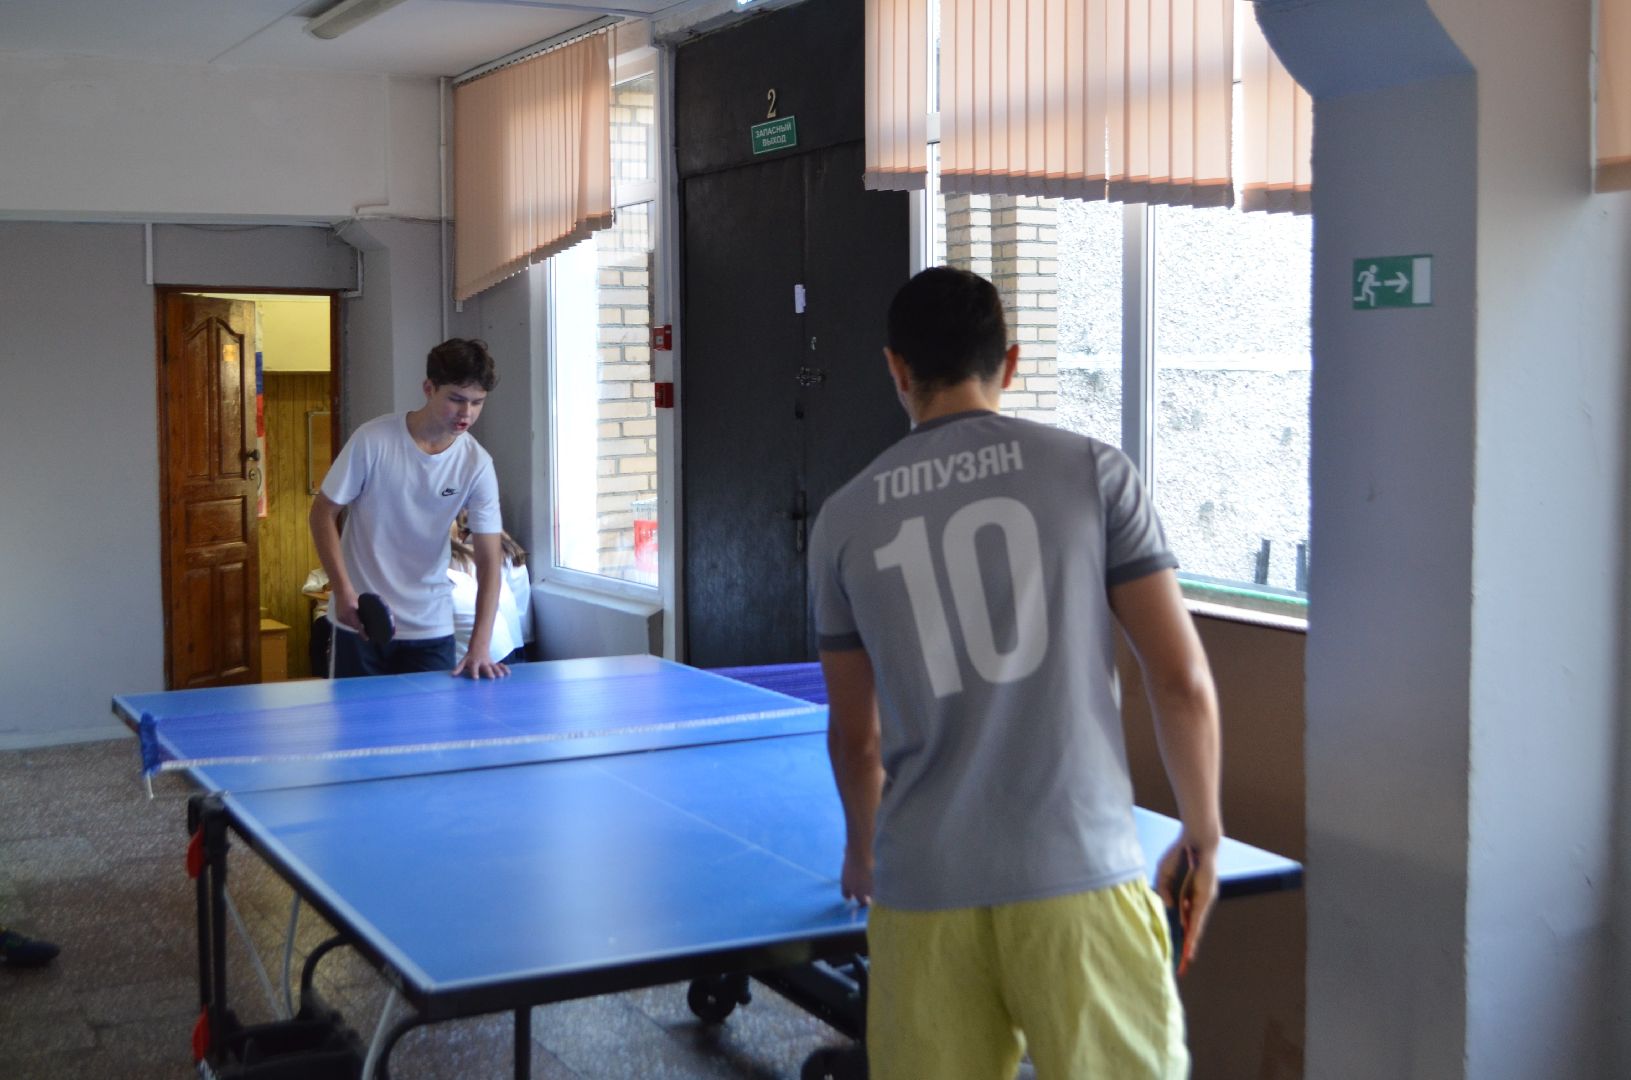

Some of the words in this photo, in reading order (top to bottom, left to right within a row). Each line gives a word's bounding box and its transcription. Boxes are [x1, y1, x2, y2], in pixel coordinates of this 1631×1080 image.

[768, 89, 776, 118] 2
[756, 122, 791, 138] ЗАПАСНЫЙ
[763, 135, 786, 147] ВЫХОД
[873, 440, 1024, 505] ТОПУЗЯН
[873, 496, 1049, 699] 10
